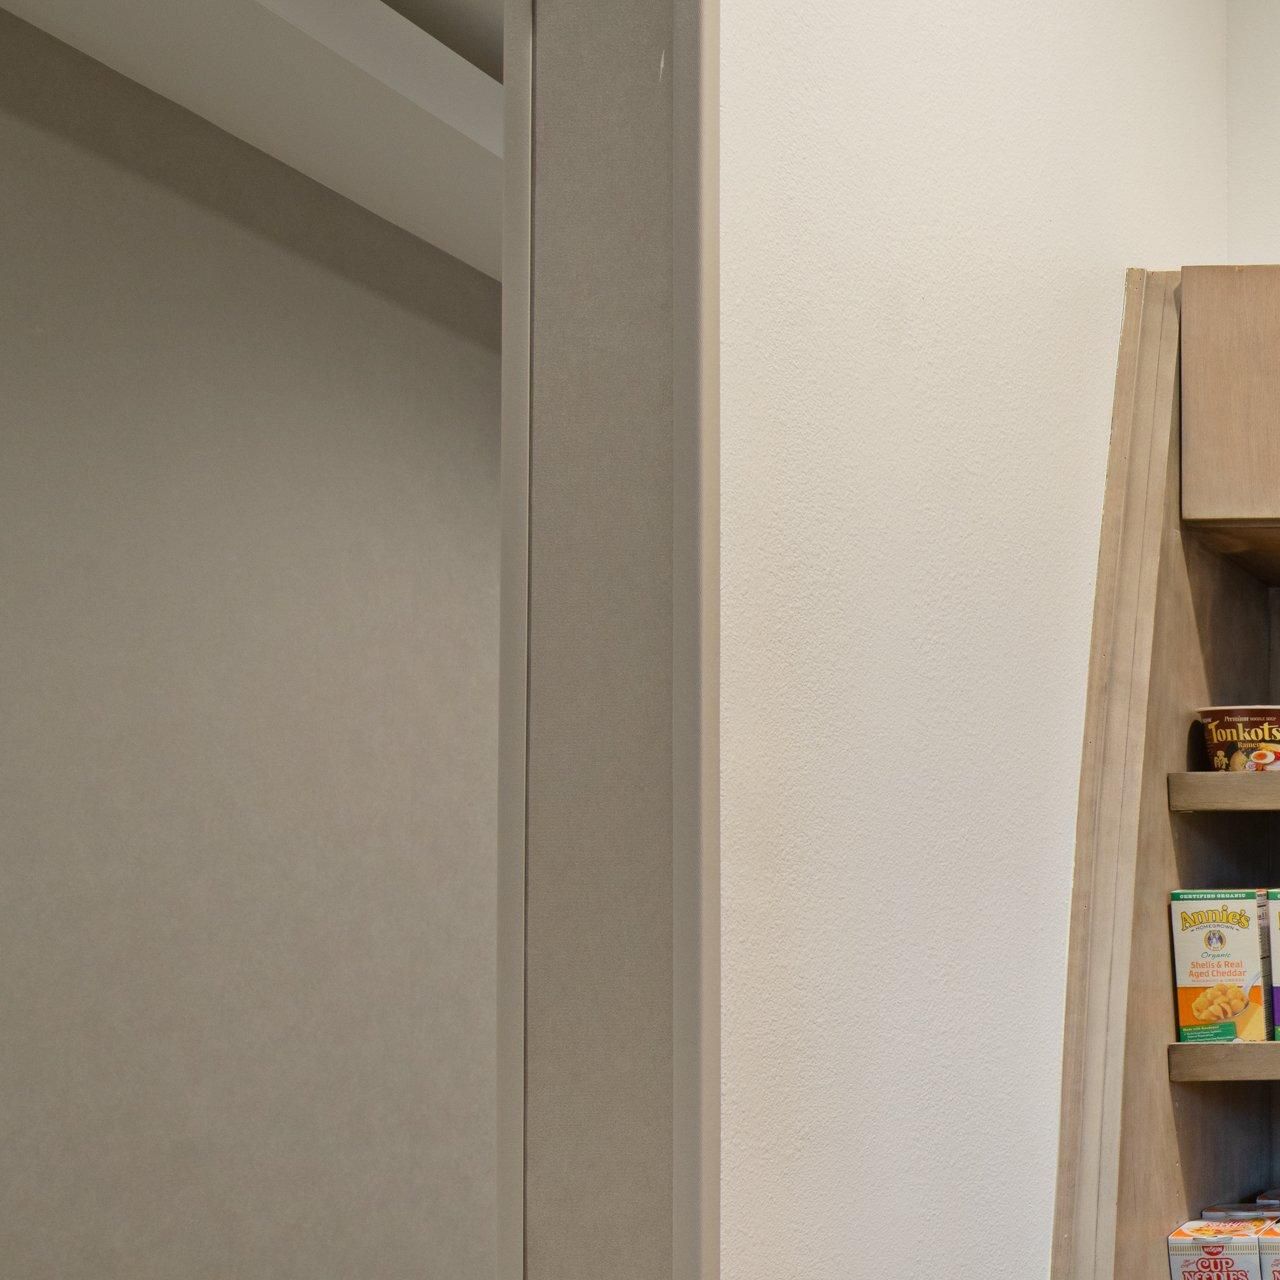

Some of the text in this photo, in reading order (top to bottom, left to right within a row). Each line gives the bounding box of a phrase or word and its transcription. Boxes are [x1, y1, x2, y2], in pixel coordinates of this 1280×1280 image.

[1180, 904, 1250, 931] Annie's
[1200, 951, 1232, 960] Organic
[1191, 961, 1243, 969] Shells & Real
[1188, 969, 1247, 979] Aged Cheddar
[1196, 1257, 1234, 1272] CUP
